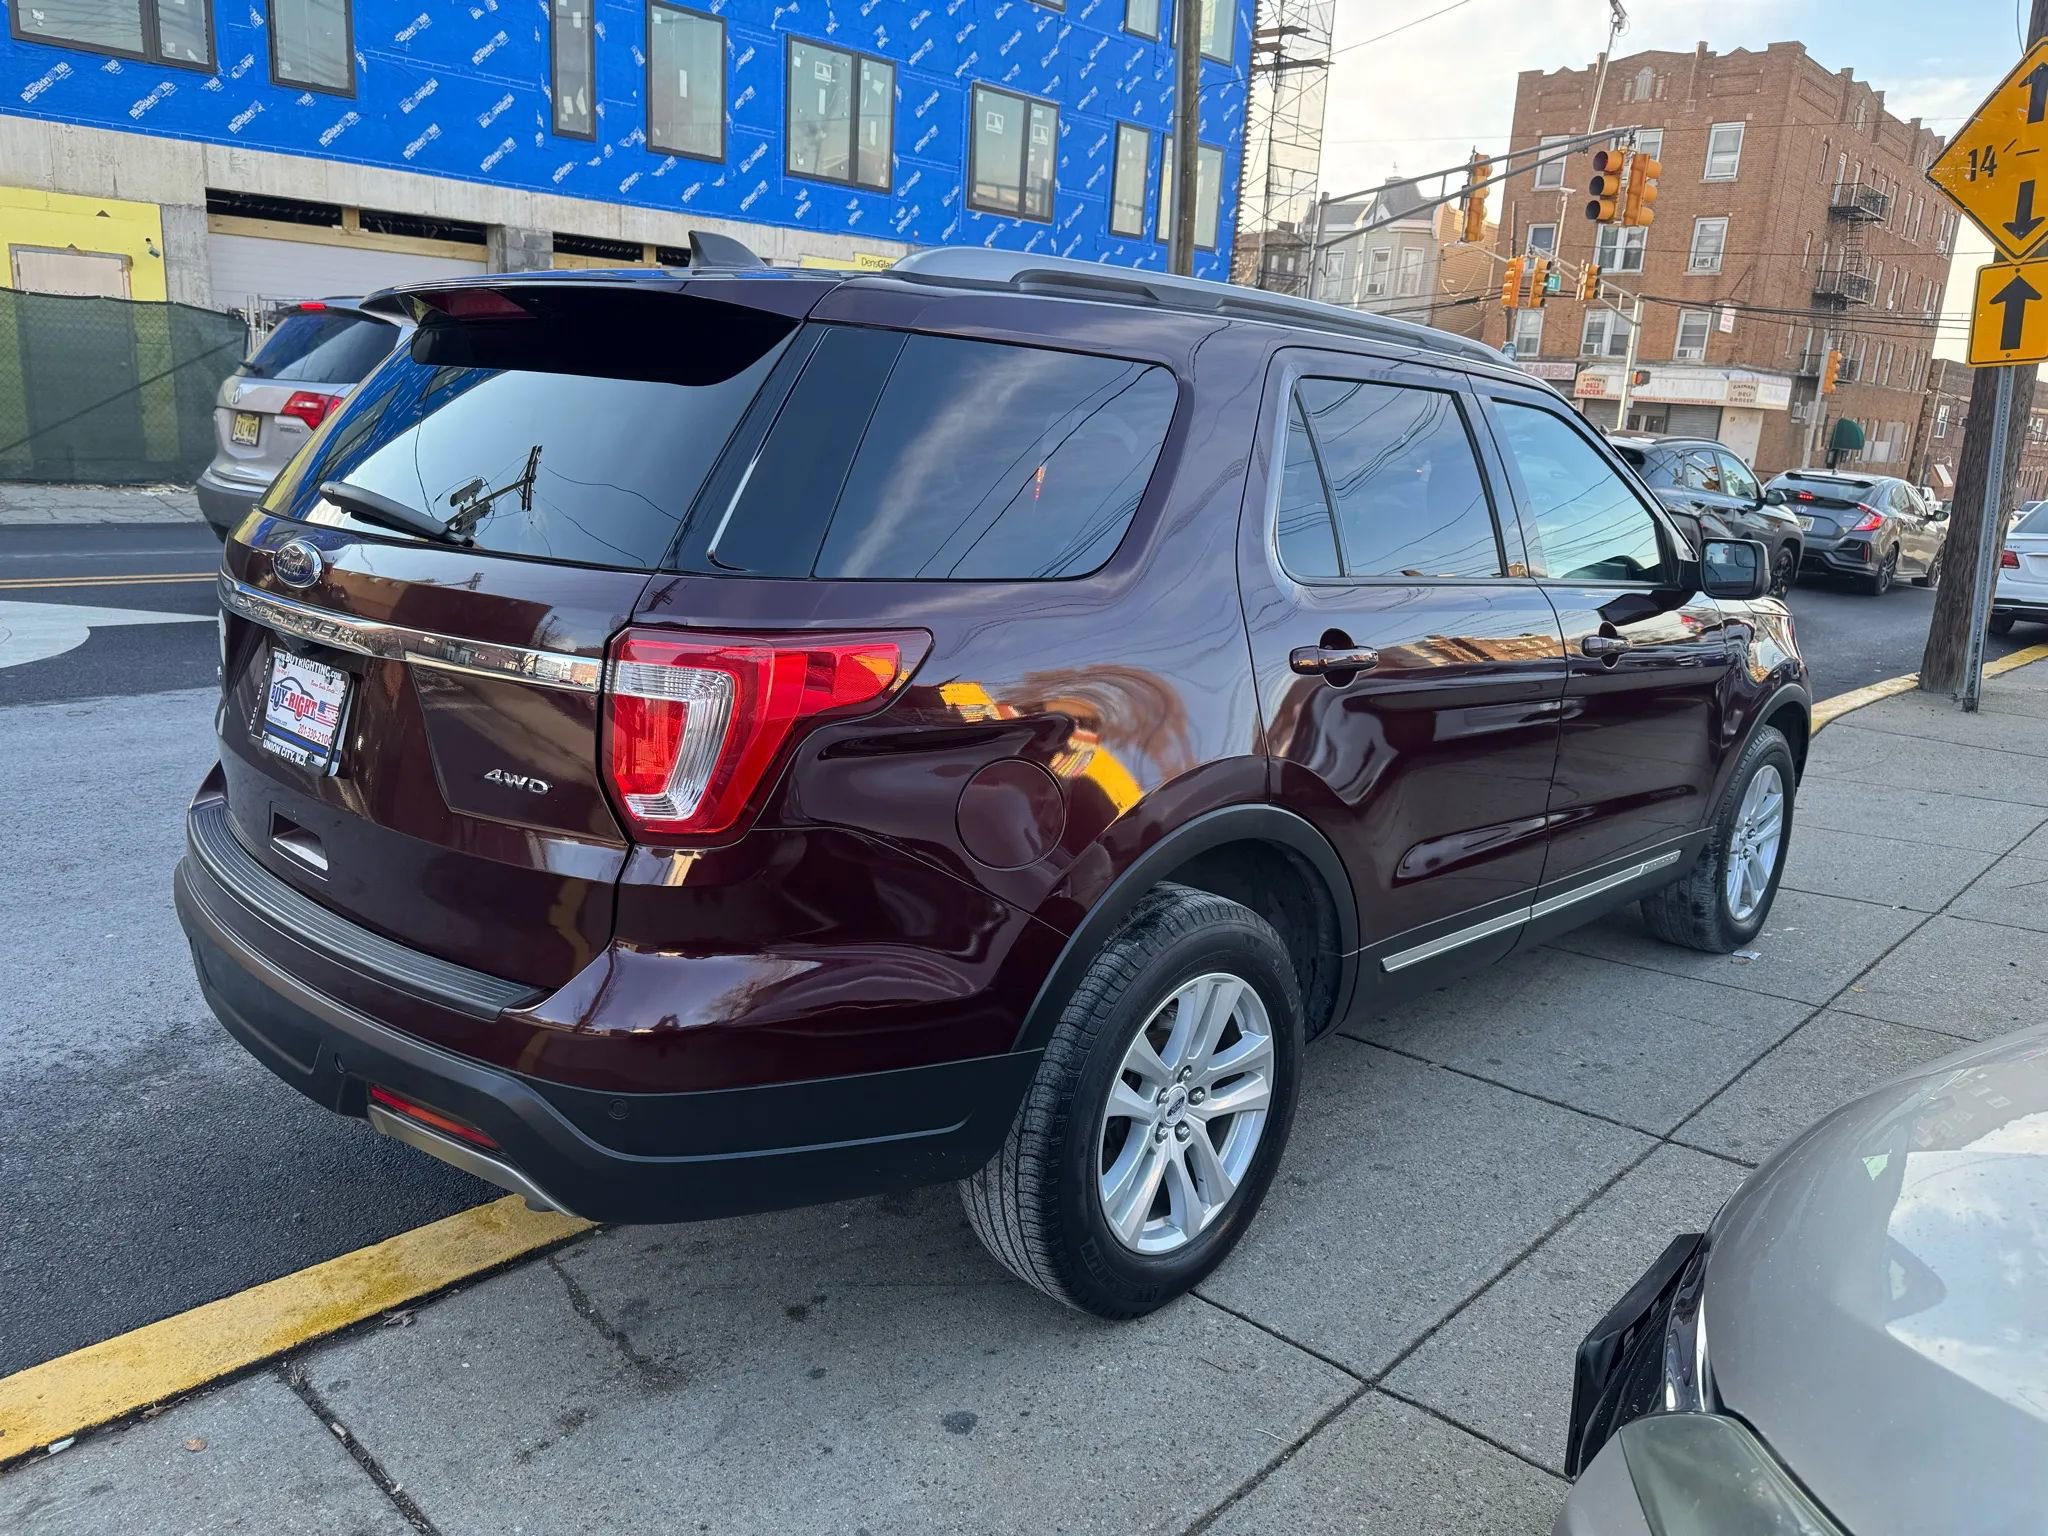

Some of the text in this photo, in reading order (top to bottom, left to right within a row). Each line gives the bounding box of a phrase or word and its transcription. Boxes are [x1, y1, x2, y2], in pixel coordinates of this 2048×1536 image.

[20, 76, 51, 102] Blueskin
[263, 740, 281, 756] UNION
[484, 768, 549, 796] 4WD
